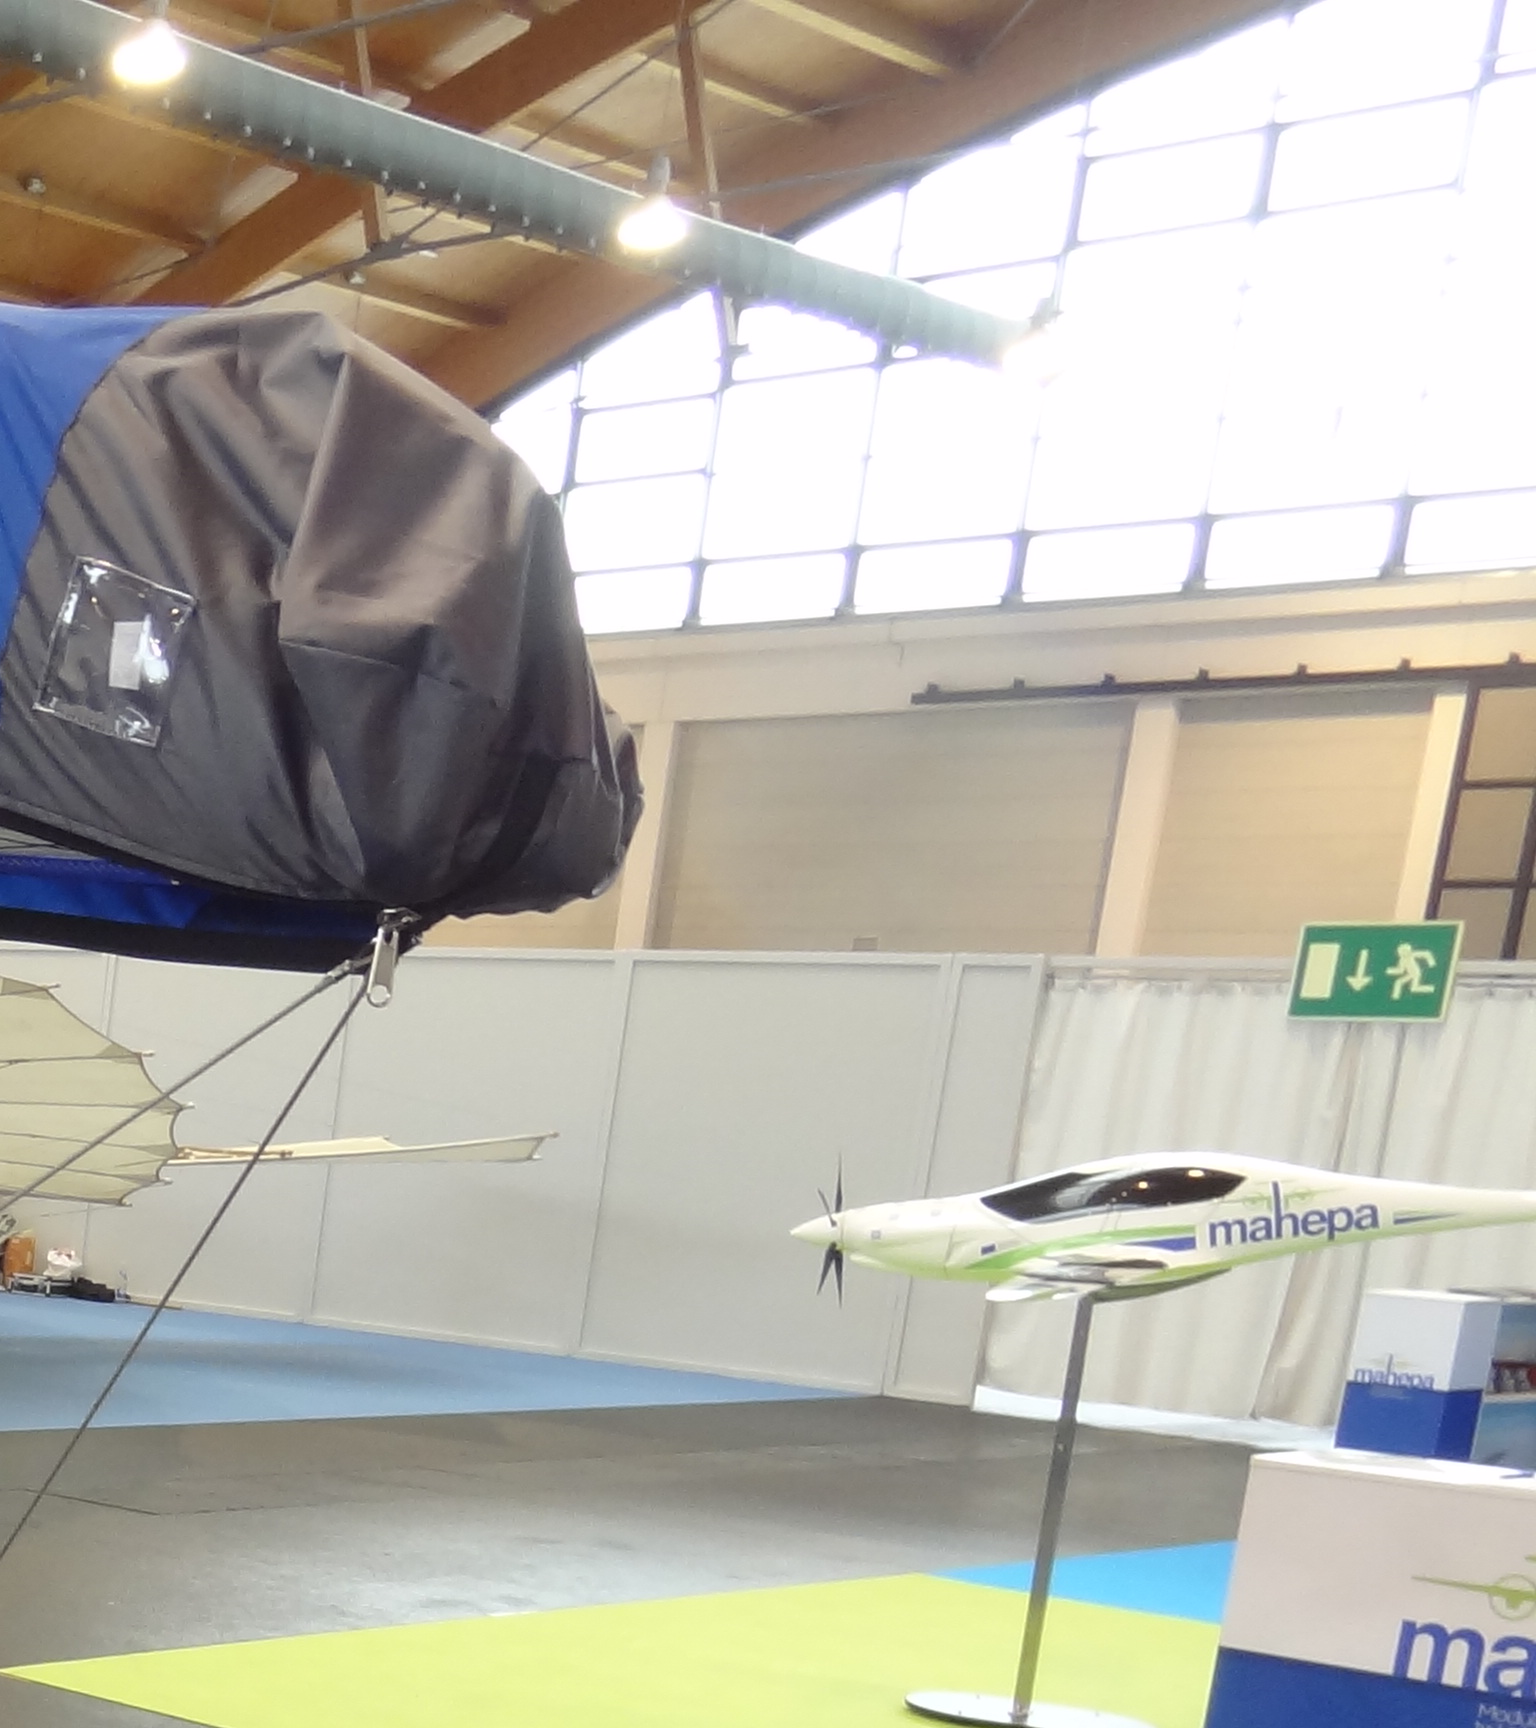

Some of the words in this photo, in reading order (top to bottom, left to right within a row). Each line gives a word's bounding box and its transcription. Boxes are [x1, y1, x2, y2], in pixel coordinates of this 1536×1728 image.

[1207, 1180, 1381, 1248] mahepa
[1354, 1354, 1435, 1391] mahepa
[1392, 1618, 1536, 1698] ma
